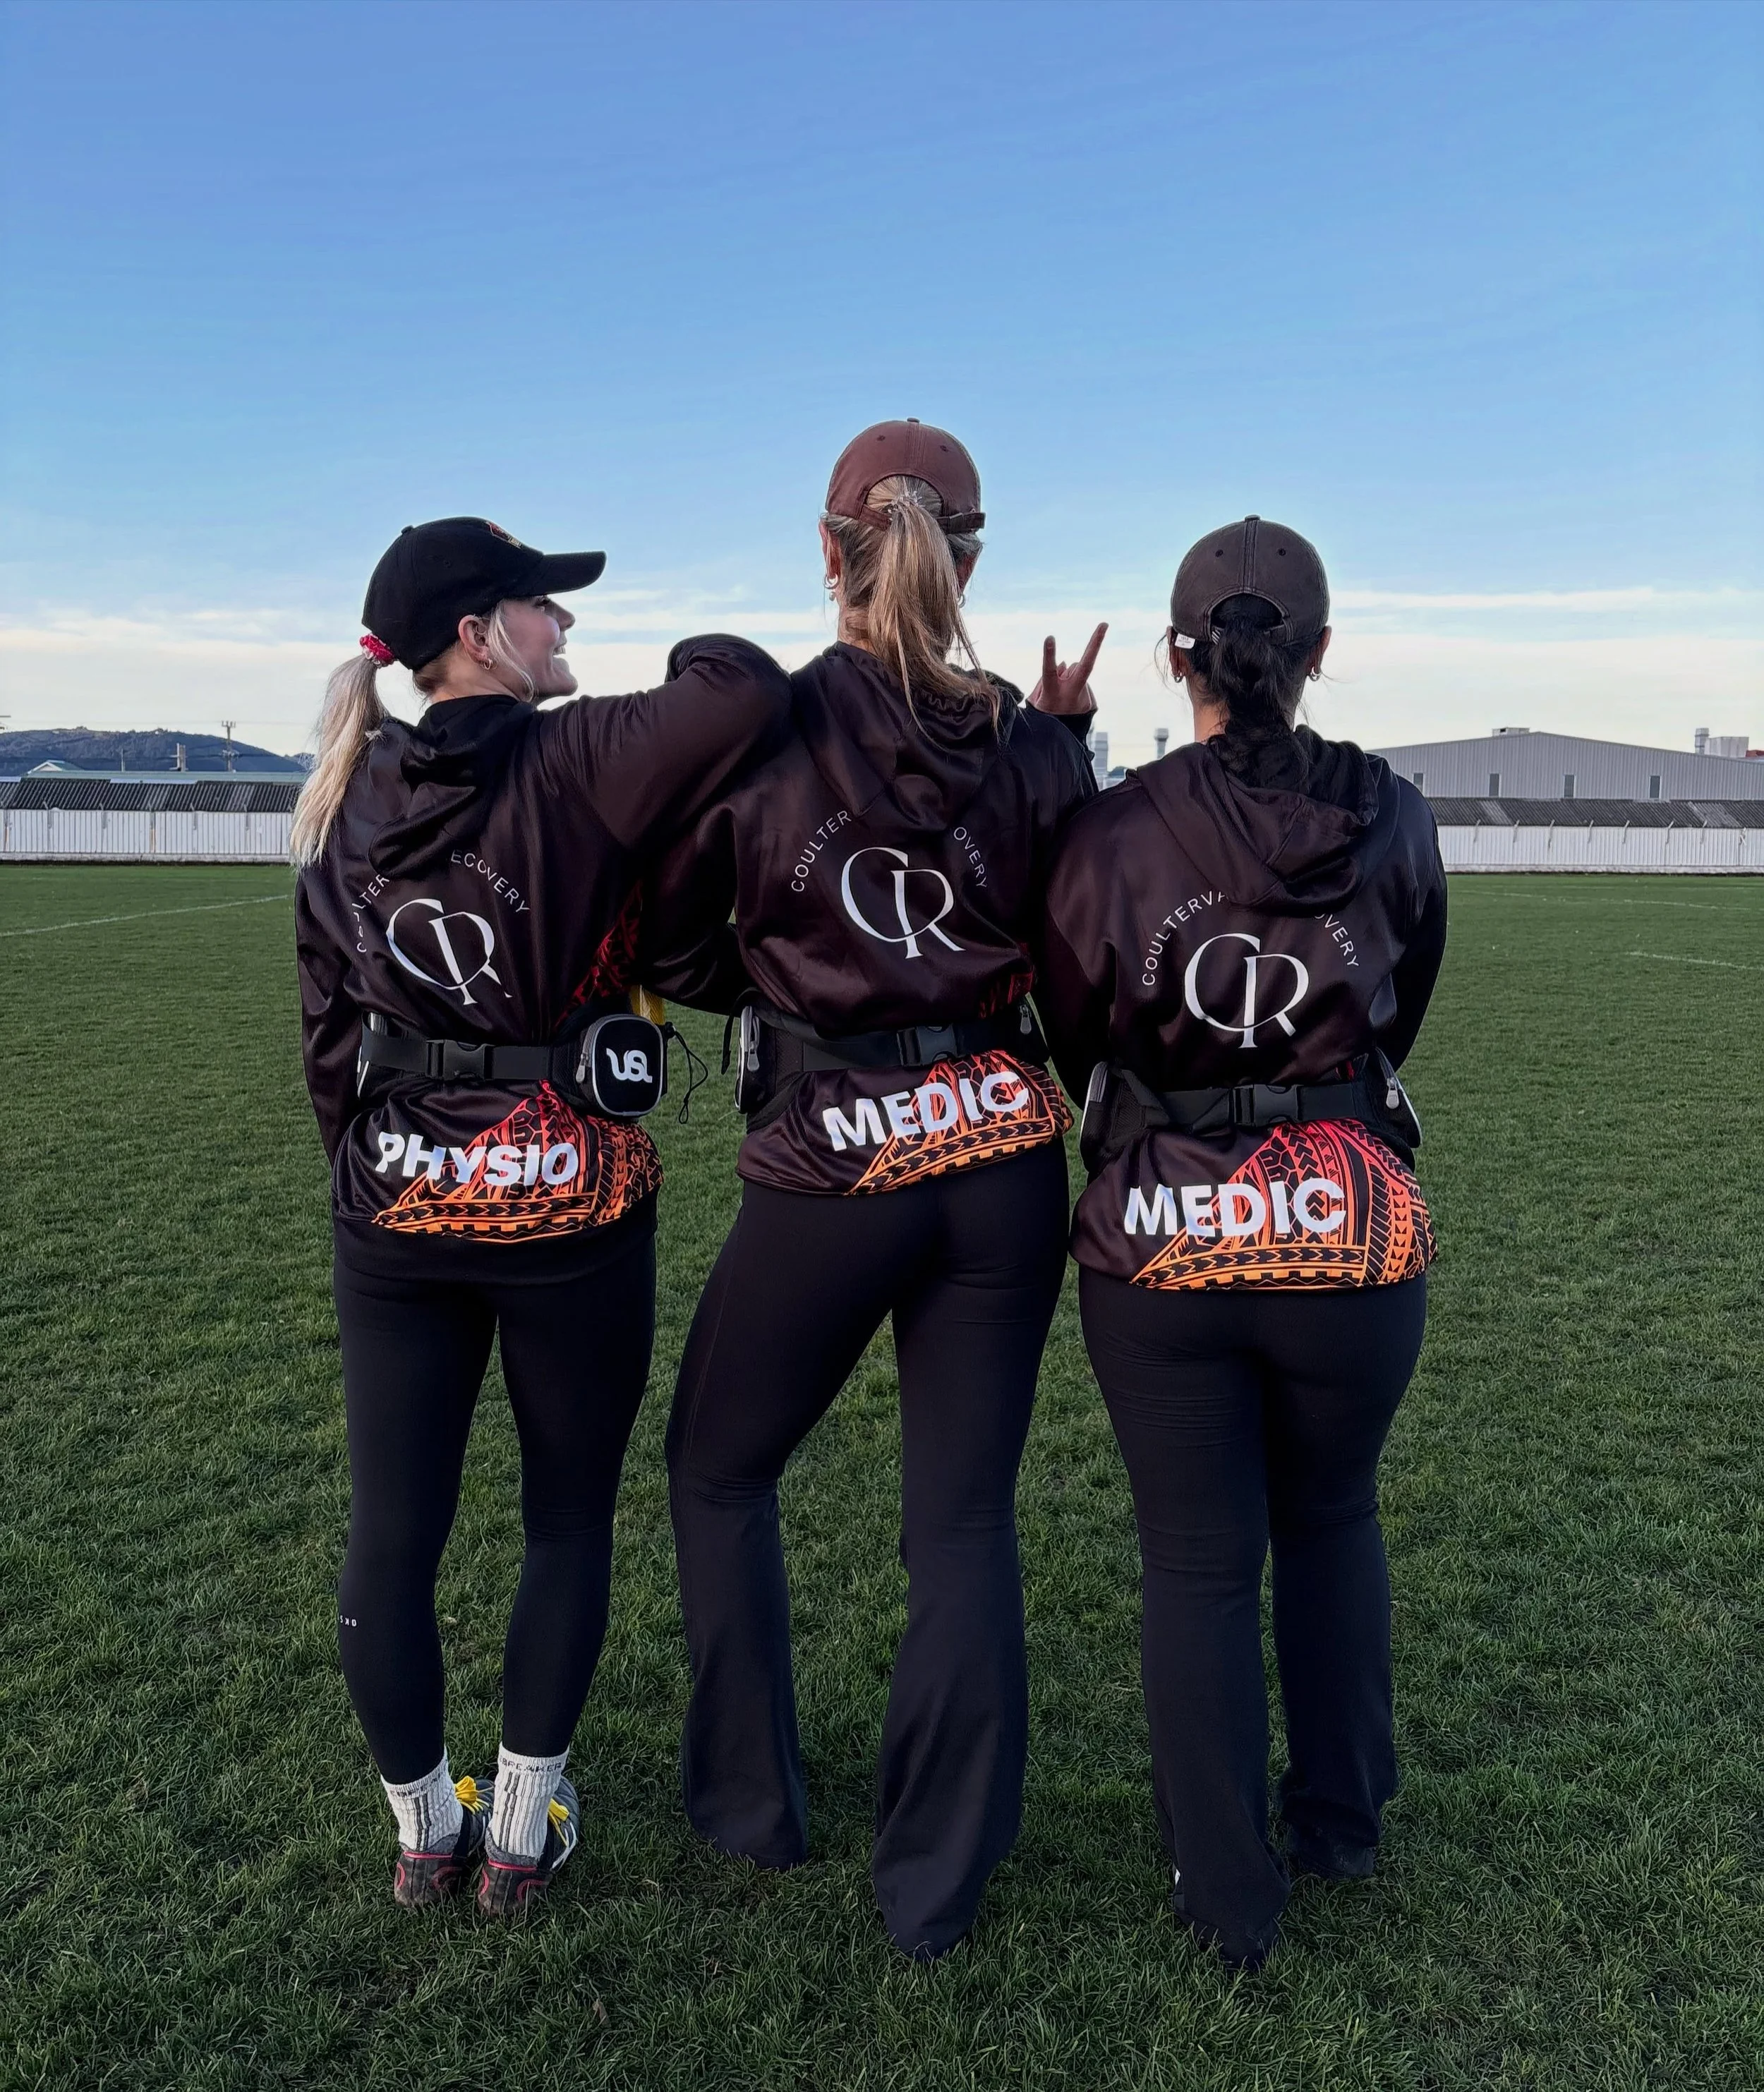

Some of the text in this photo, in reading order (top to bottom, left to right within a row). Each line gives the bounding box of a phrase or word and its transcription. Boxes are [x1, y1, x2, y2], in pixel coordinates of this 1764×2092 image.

[791, 810, 852, 892] COULTER
[822, 1070, 1029, 1151] MEDIC
[375, 1131, 579, 1186] PHYSIO
[1124, 1178, 1346, 1237] MEDIC
